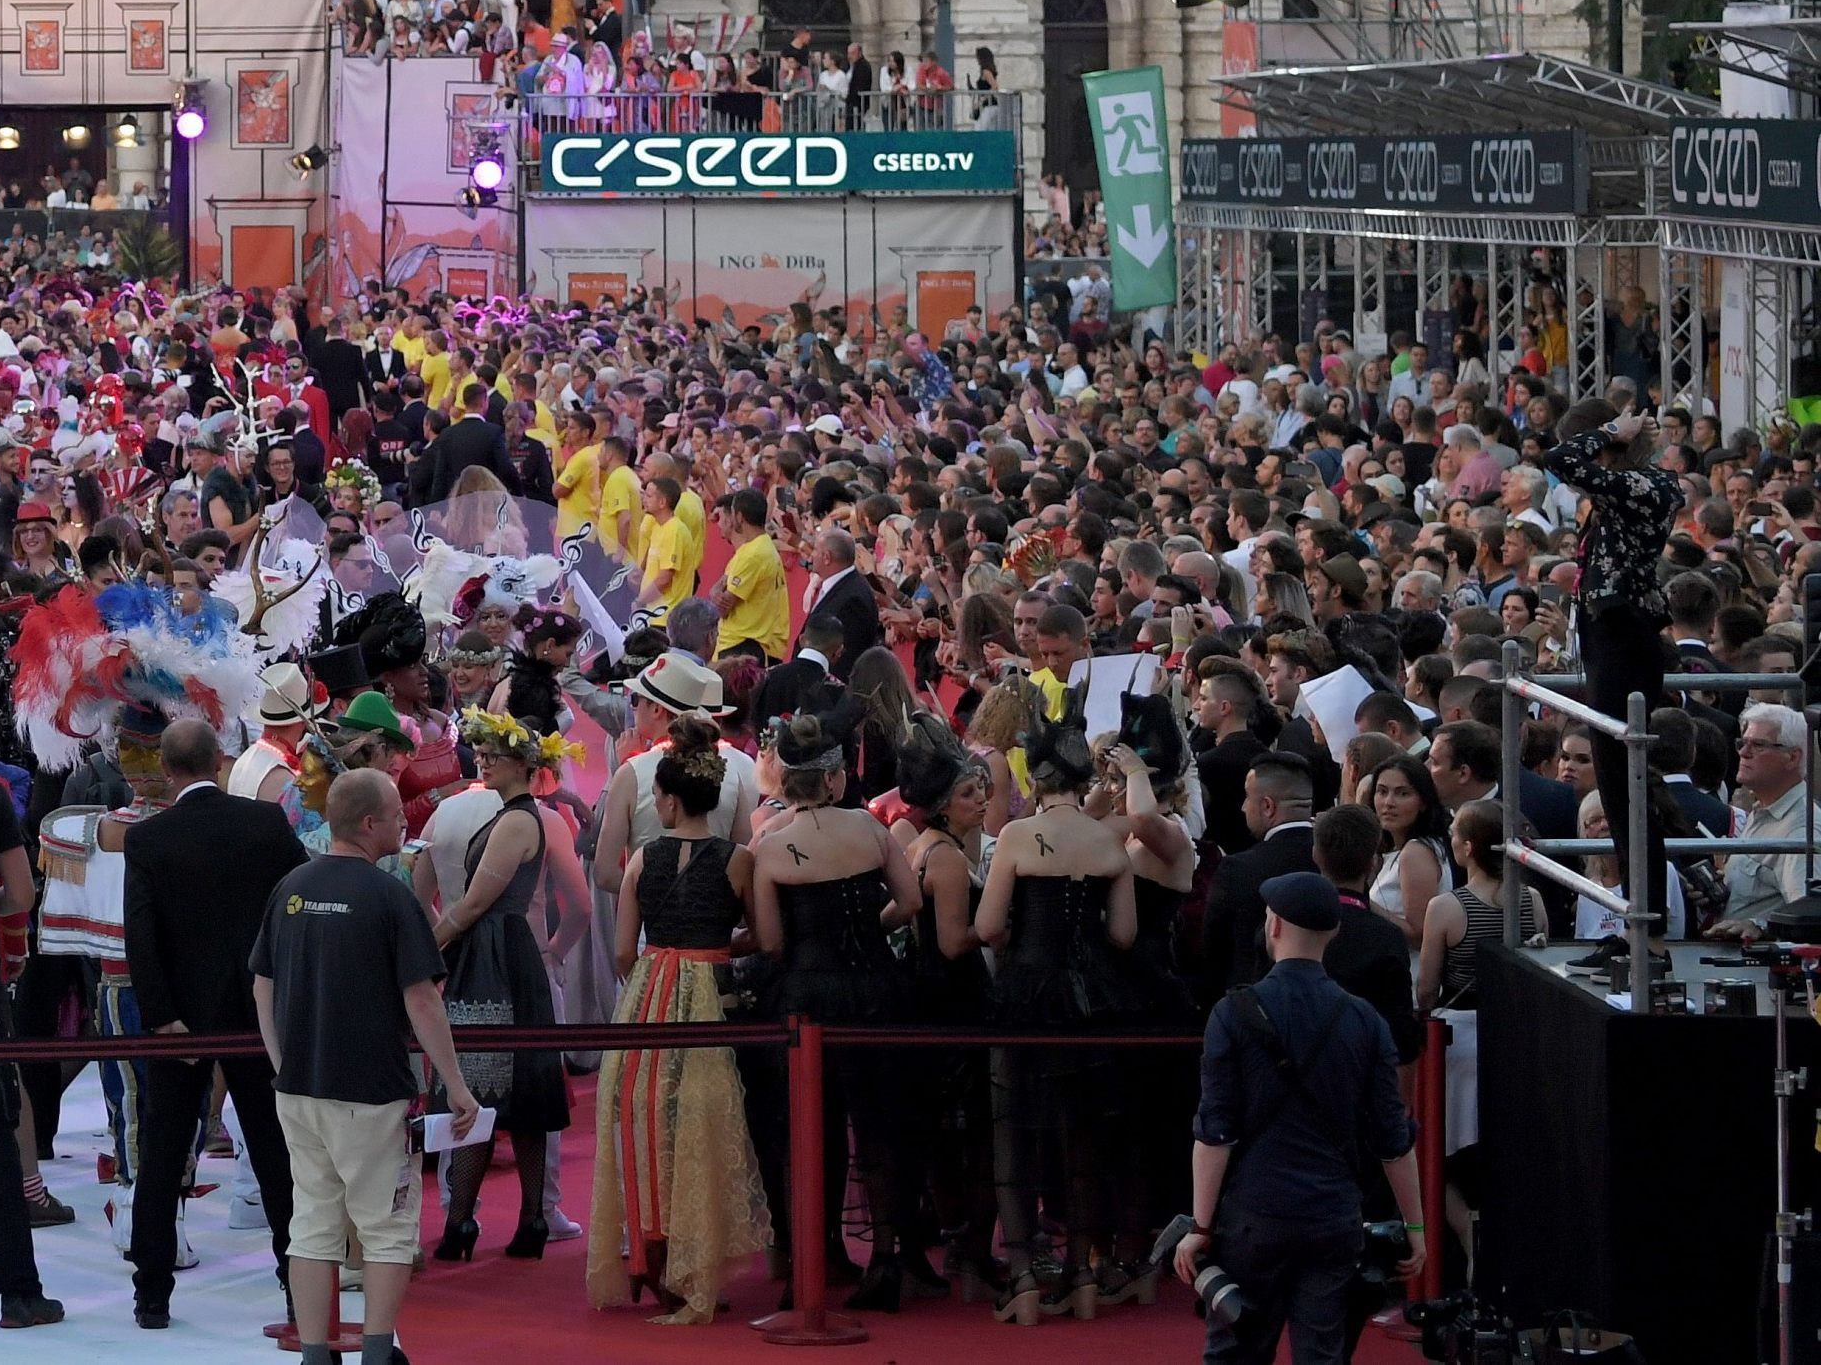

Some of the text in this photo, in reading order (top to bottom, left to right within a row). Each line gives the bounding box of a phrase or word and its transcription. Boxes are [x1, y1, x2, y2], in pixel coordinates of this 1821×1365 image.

[873, 152, 974, 172] CSEED.TV
[720, 255, 825, 269] ING DiBa
[381, 441, 404, 451] ORF
[303, 900, 348, 912] TEAMWORK
